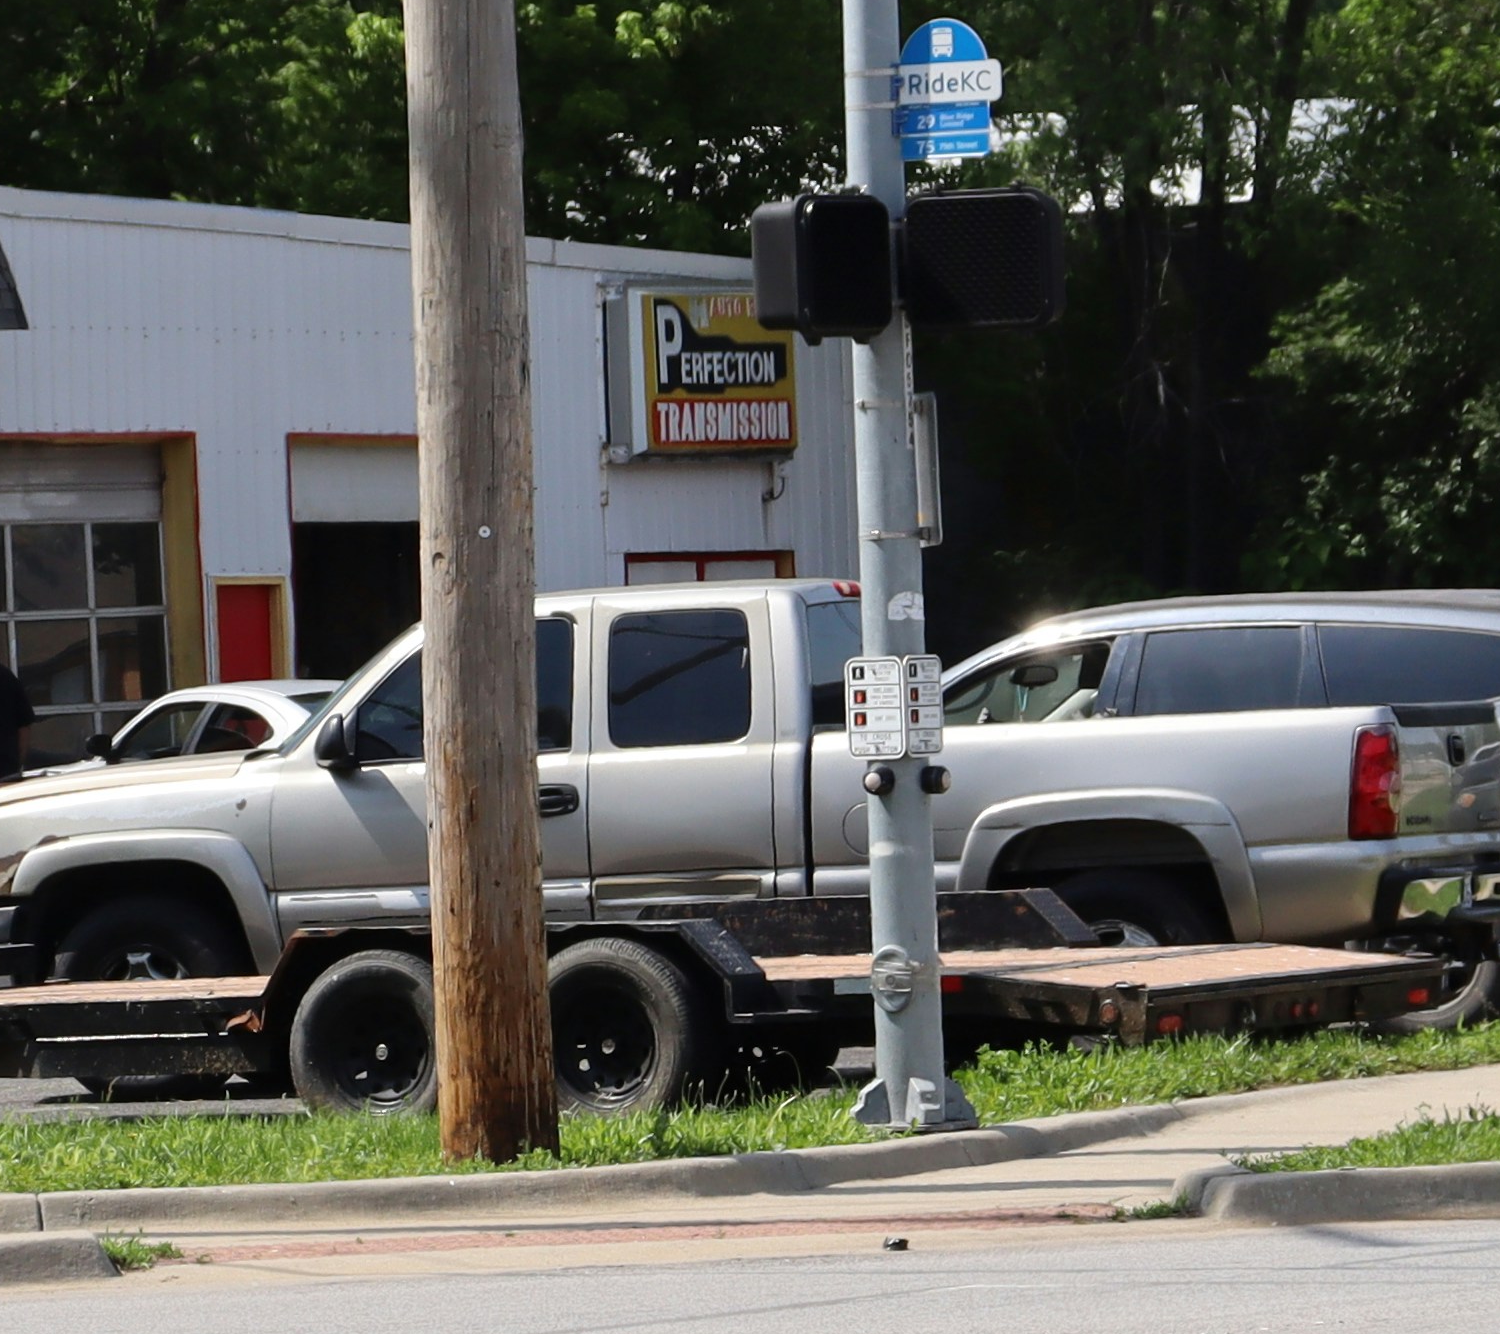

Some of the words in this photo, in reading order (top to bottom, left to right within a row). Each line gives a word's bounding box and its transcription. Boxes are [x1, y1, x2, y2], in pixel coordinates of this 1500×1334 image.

[908, 69, 992, 96] RideKC
[916, 113, 936, 130] 29
[916, 139, 936, 155] 75
[656, 400, 790, 442] TRANSMISSION
